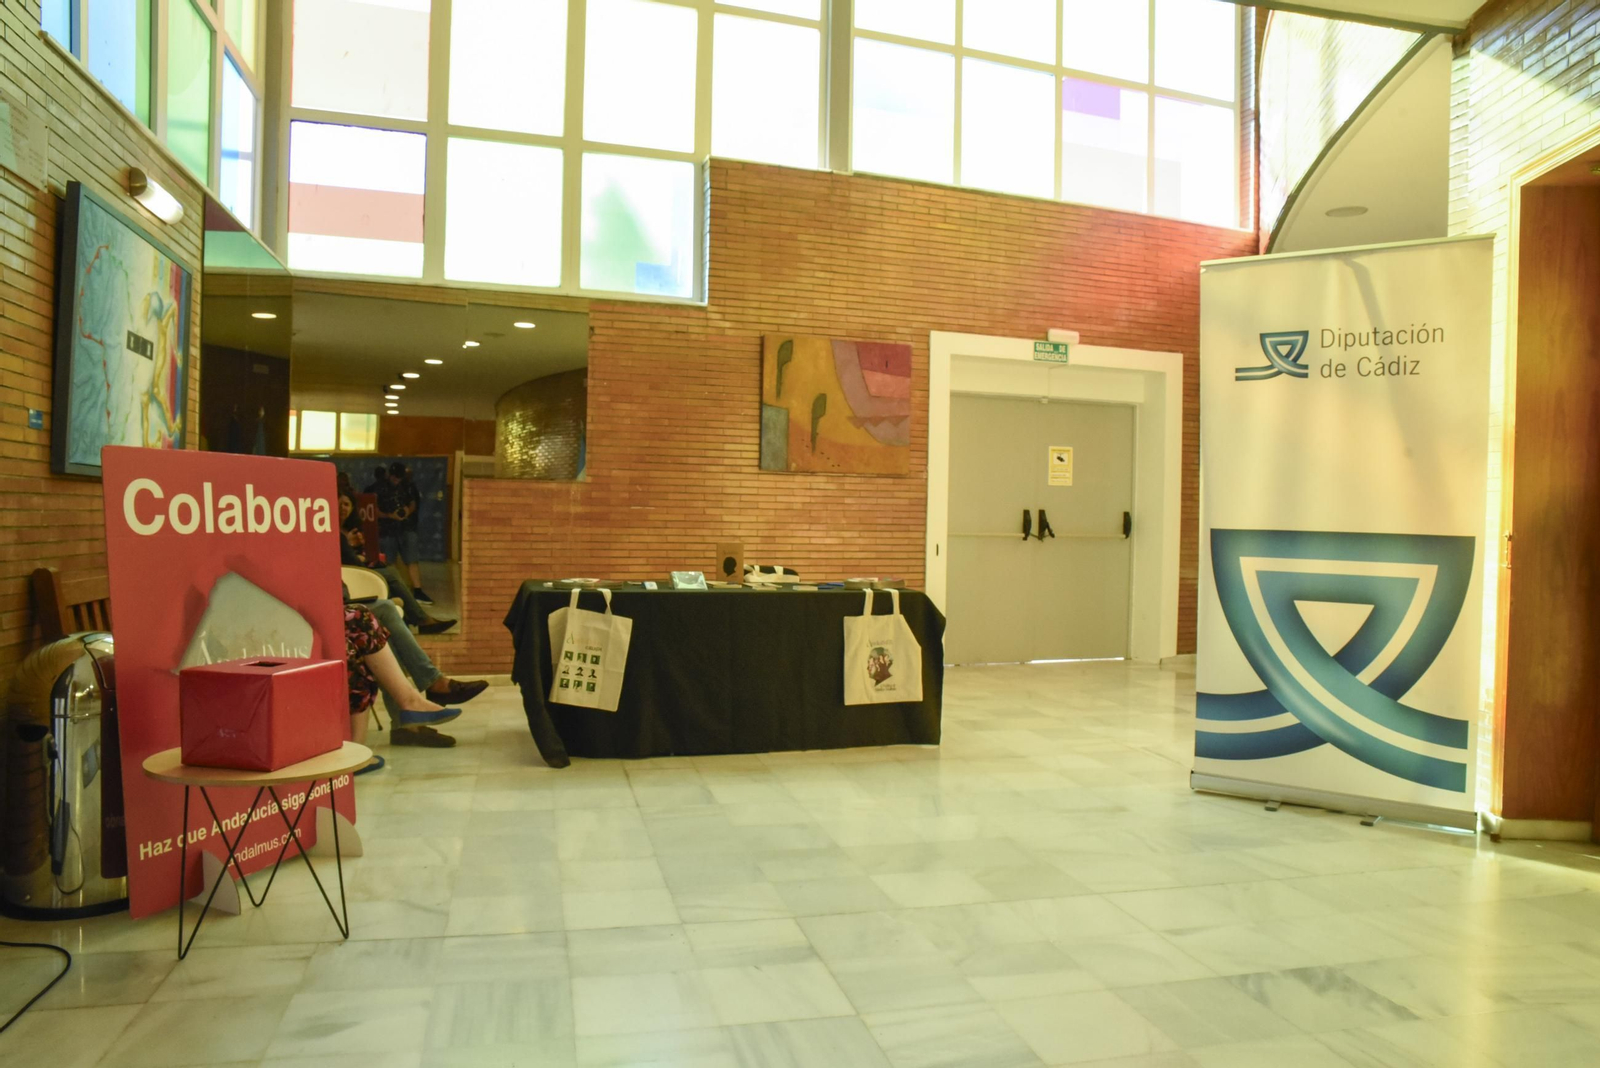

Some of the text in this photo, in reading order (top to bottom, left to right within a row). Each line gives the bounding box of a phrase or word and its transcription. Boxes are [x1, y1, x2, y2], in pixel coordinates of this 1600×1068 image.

[1036, 343, 1066, 353] SALIDA DE
[1320, 323, 1444, 351] Diputación
[1320, 355, 1420, 379] de Cádiz
[123, 477, 332, 536] Colabora
[139, 838, 173, 861] Haz
[211, 800, 279, 837] Andalucía
[281, 792, 306, 811] siga
